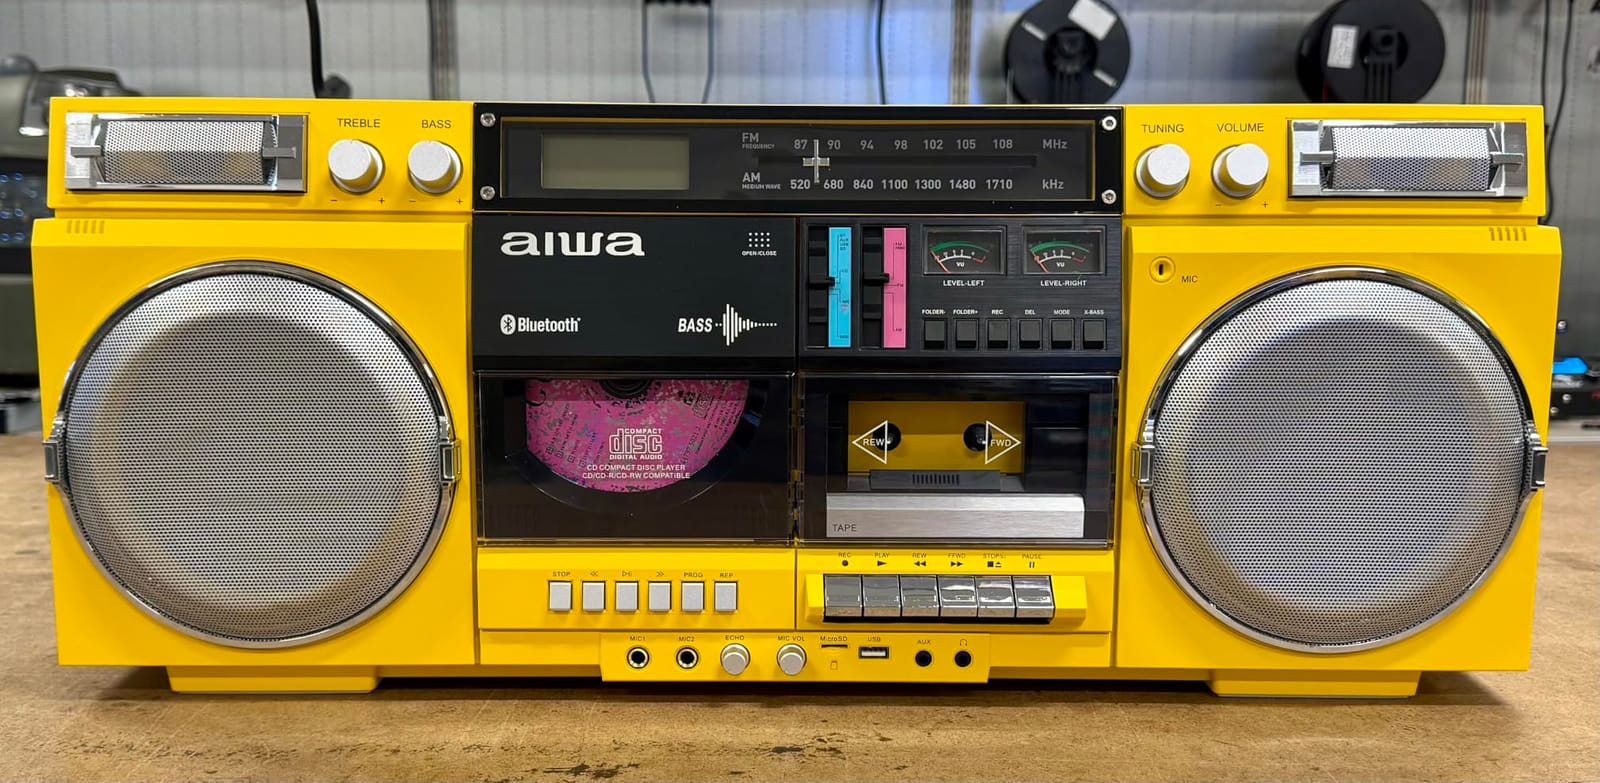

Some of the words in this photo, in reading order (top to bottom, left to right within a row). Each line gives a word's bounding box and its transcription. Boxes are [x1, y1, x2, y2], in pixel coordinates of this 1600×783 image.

[337, 118, 381, 128] TREBLE
[421, 119, 452, 129] BASS
[1141, 123, 1185, 134] TUNING
[1216, 122, 1265, 133] VOLUME
[742, 132, 760, 143] FM
[794, 139, 808, 150] 87
[827, 139, 841, 150] 90
[859, 139, 874, 150] 94
[894, 139, 909, 150] 98
[922, 139, 944, 150] 102
[955, 139, 976, 150] 105
[992, 139, 1014, 150] 108
[1042, 139, 1068, 150] MHz
[742, 172, 761, 183] AM
[790, 179, 811, 190] 520
[823, 179, 844, 190] 680
[853, 179, 874, 190] 840
[881, 179, 909, 190] 1100
[914, 179, 942, 190] 1300
[949, 179, 976, 190] 1480
[985, 179, 1013, 190] 1710
[1042, 179, 1065, 190] kHz
[500, 231, 646, 257] aiwa
[943, 279, 985, 287] LEVEL-LEFT
[1181, 275, 1198, 283] MIC
[517, 317, 579, 333] Bluetooth
[678, 318, 713, 333] BASS
[862, 438, 885, 447] REW
[990, 439, 1012, 447] FWD
[833, 524, 857, 532] TAPE
